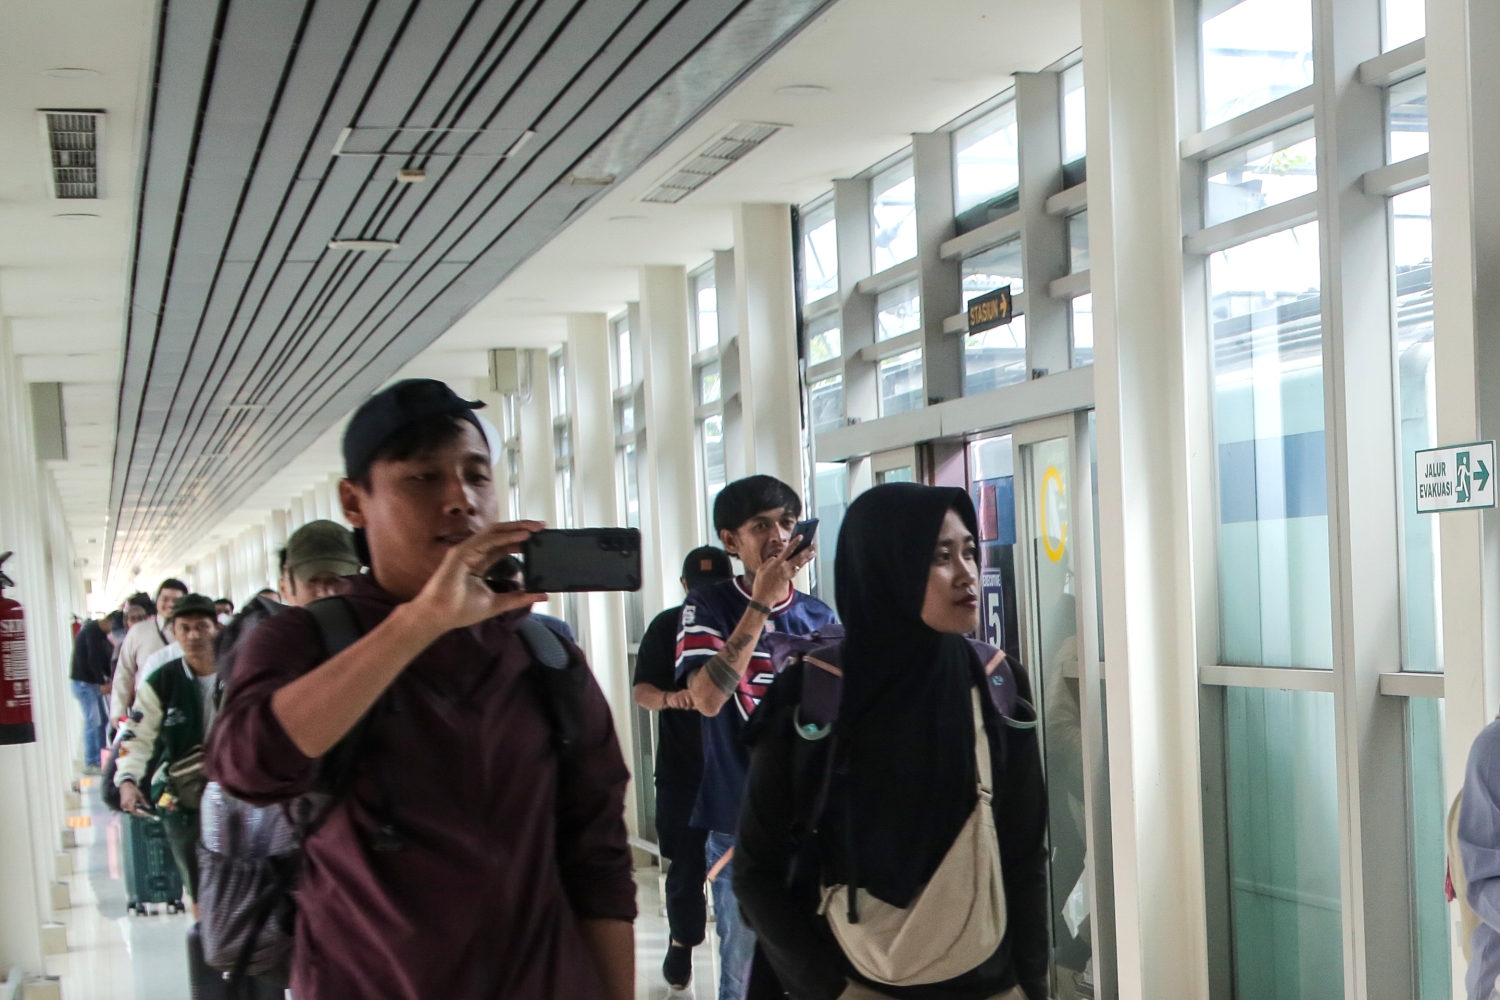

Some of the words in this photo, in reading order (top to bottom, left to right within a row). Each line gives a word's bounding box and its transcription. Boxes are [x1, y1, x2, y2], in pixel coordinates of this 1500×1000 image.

[970, 299, 998, 326] STASIUN
[1424, 461, 1446, 478] JALUR
[1419, 481, 1453, 499] EVAKUASI
[1040, 465, 1067, 563] C
[988, 592, 1002, 649] 5
